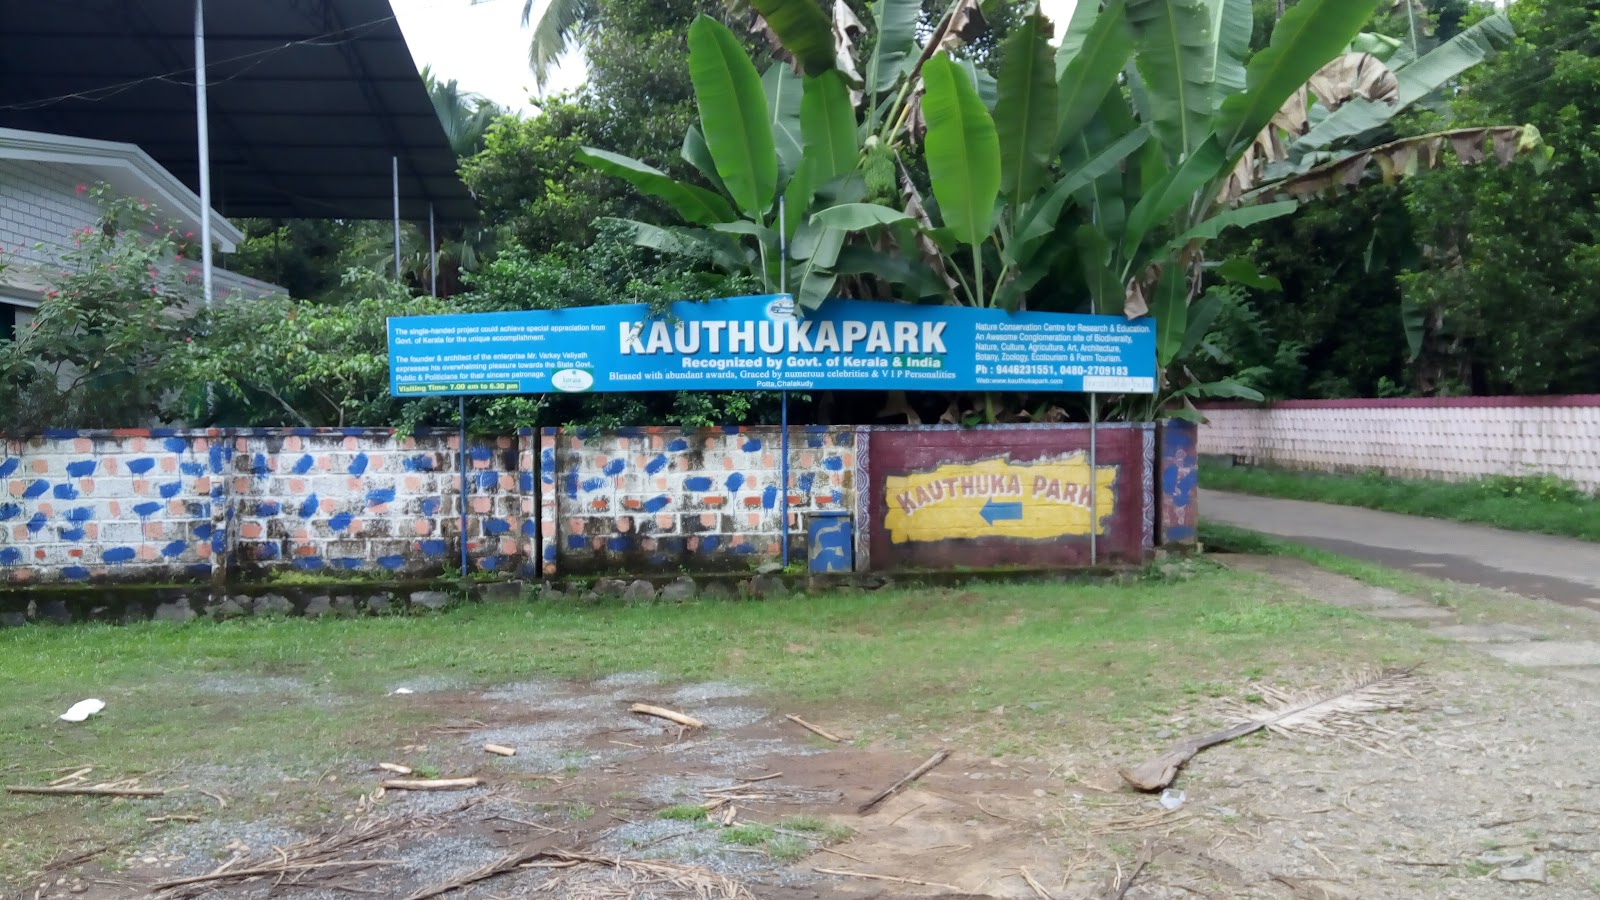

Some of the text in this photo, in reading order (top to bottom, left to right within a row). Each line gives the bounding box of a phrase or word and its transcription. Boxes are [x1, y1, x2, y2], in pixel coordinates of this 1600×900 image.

[410, 327, 454, 336] single-handed
[457, 326, 478, 335] project
[551, 324, 589, 332] appreciation
[976, 322, 998, 330] Nature
[998, 322, 1042, 331] Conservation
[1044, 323, 1066, 331] Centre
[1067, 324, 1076, 332] for
[1078, 324, 1108, 332] Research
[1110, 324, 1114, 332] &
[468, 336, 490, 344] unique
[492, 334, 546, 342] accomplishment.
[620, 320, 947, 354] KAUTHUKAPARK
[986, 332, 1018, 340] Awesome
[1019, 333, 1071, 342] Conglomeration
[1094, 334, 1133, 344] Biodiversity,
[976, 342, 1121, 352] Nature, Culture, Agriculture, Art, Architecture,
[976, 352, 1000, 362] Botany,
[1002, 353, 1029, 362] Zoology,
[1032, 353, 1068, 361] Ecotourism
[442, 363, 486, 371] overwhelming
[682, 356, 940, 370] Recognized by Govt. of Kerala & India
[609, 372, 642, 380] Blessed
[644, 371, 662, 380] with
[666, 370, 703, 380] abundant
[706, 370, 737, 380] awards,
[740, 370, 770, 378] Graced
[772, 370, 782, 380] by
[827, 370, 868, 378] celebrities
[904, 370, 956, 378] Personalities
[976, 364, 988, 374] Ph
[996, 364, 1058, 375] 9446231551,
[1060, 366, 1128, 376] 0480-2709183
[896, 474, 1092, 516] KAUTHUKA PARK
